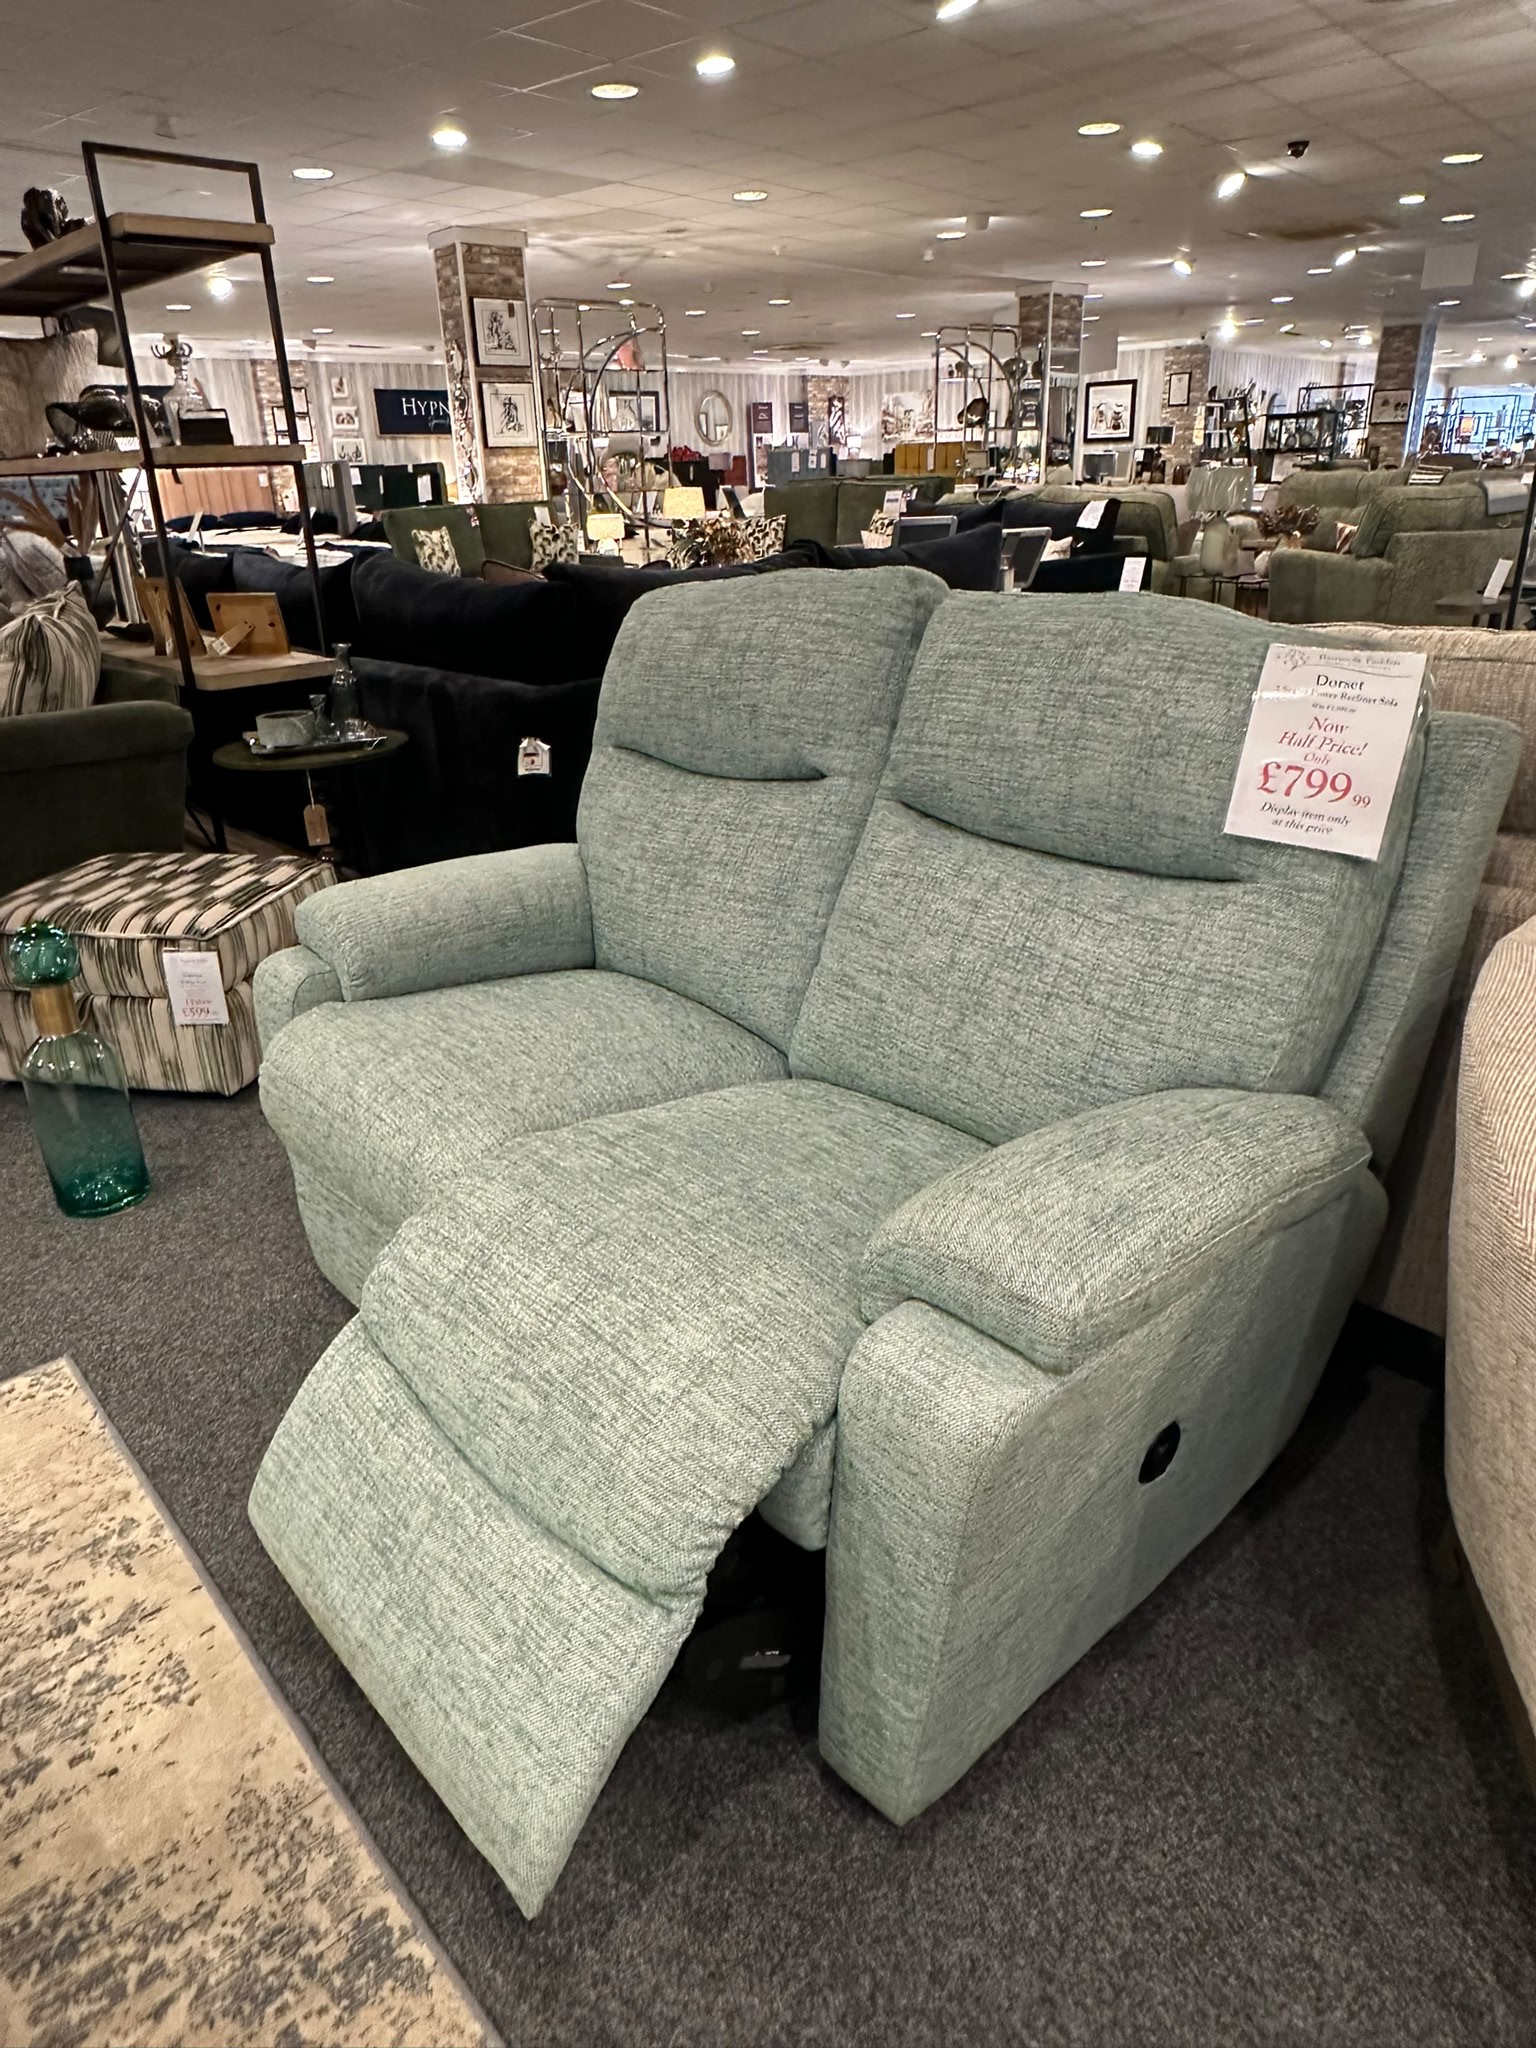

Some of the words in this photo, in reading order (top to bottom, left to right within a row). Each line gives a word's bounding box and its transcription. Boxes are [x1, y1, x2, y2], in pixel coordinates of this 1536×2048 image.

[1316, 674, 1365, 691] Dorset
[1340, 692, 1377, 705] Recliner
[1379, 696, 1399, 708] Sofa
[1308, 716, 1348, 735] Now
[1278, 731, 1317, 749] Half
[1318, 736, 1369, 757] Price!
[1303, 752, 1332, 766] Only
[1260, 801, 1299, 817] Display
[1300, 808, 1325, 822] item
[1326, 814, 1352, 828] only
[1272, 818, 1283, 826] at
[1285, 818, 1304, 830] this
[1305, 824, 1334, 836] price
